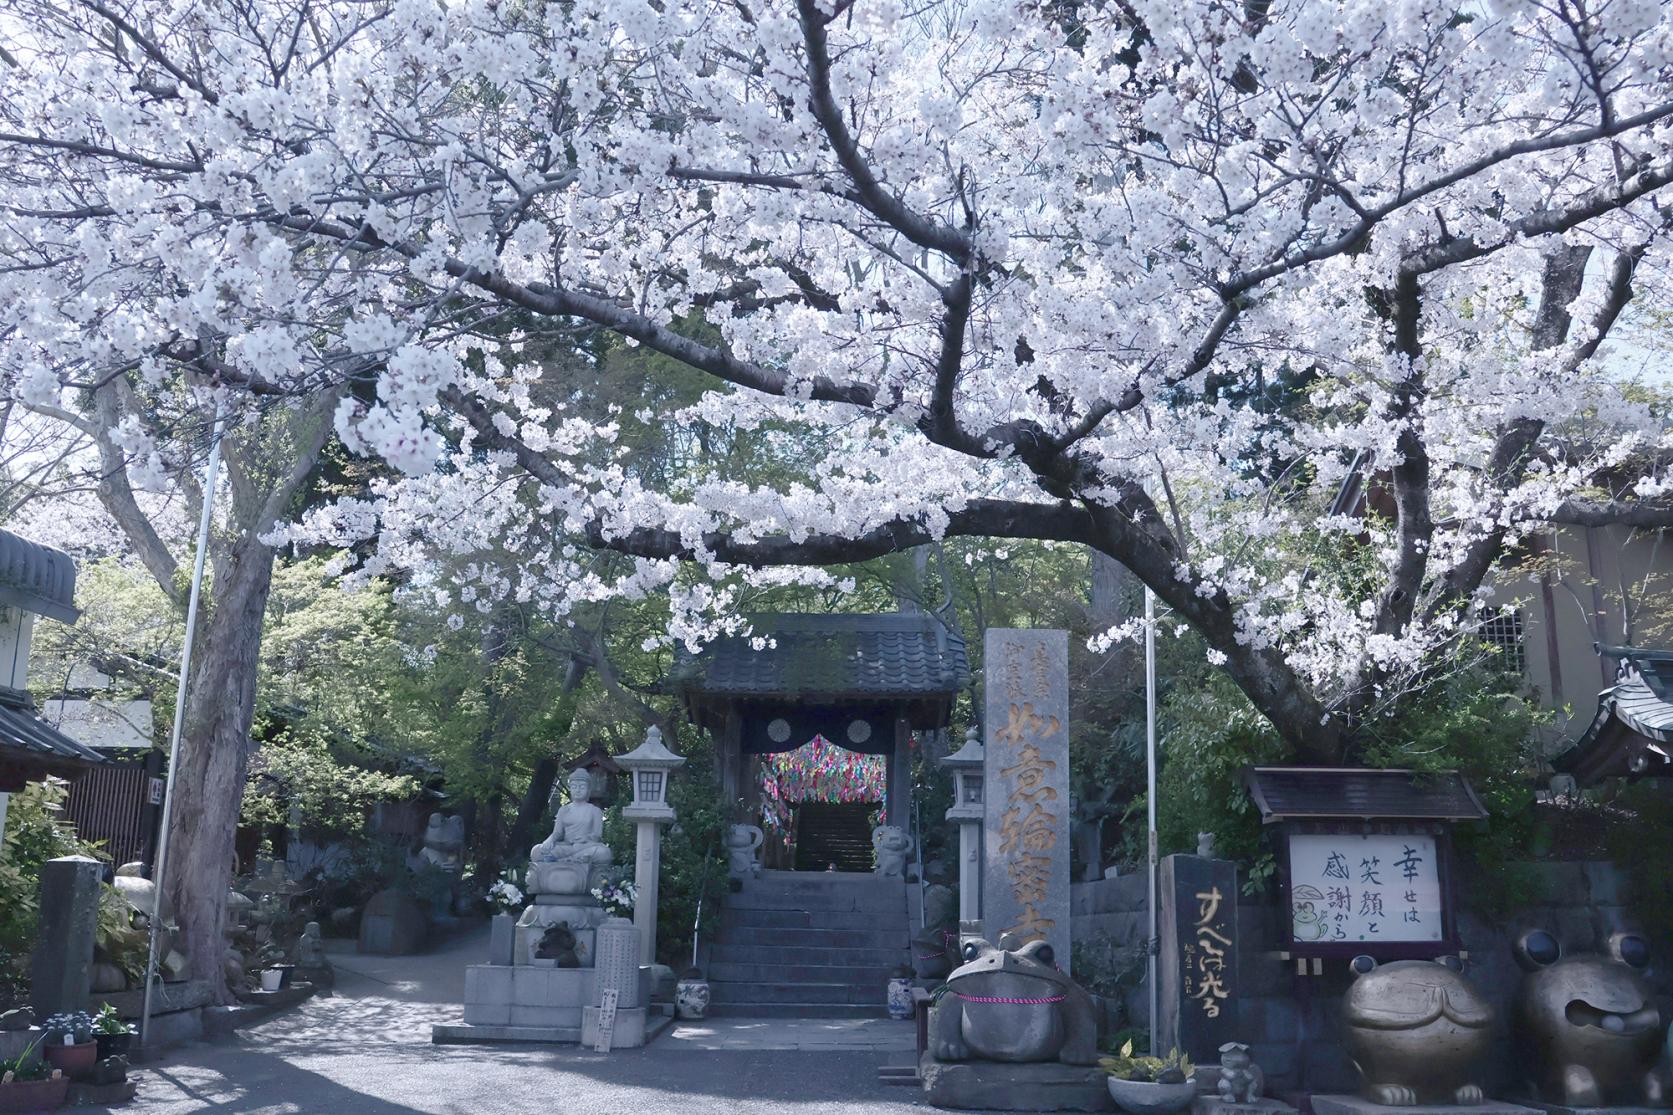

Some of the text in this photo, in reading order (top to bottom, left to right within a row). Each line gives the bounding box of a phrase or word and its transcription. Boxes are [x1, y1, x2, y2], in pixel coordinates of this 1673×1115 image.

[1322, 851, 1351, 940] 感謝から
[1359, 856, 1385, 933] 笑顔と
[1393, 845, 1422, 923] 幸せは
